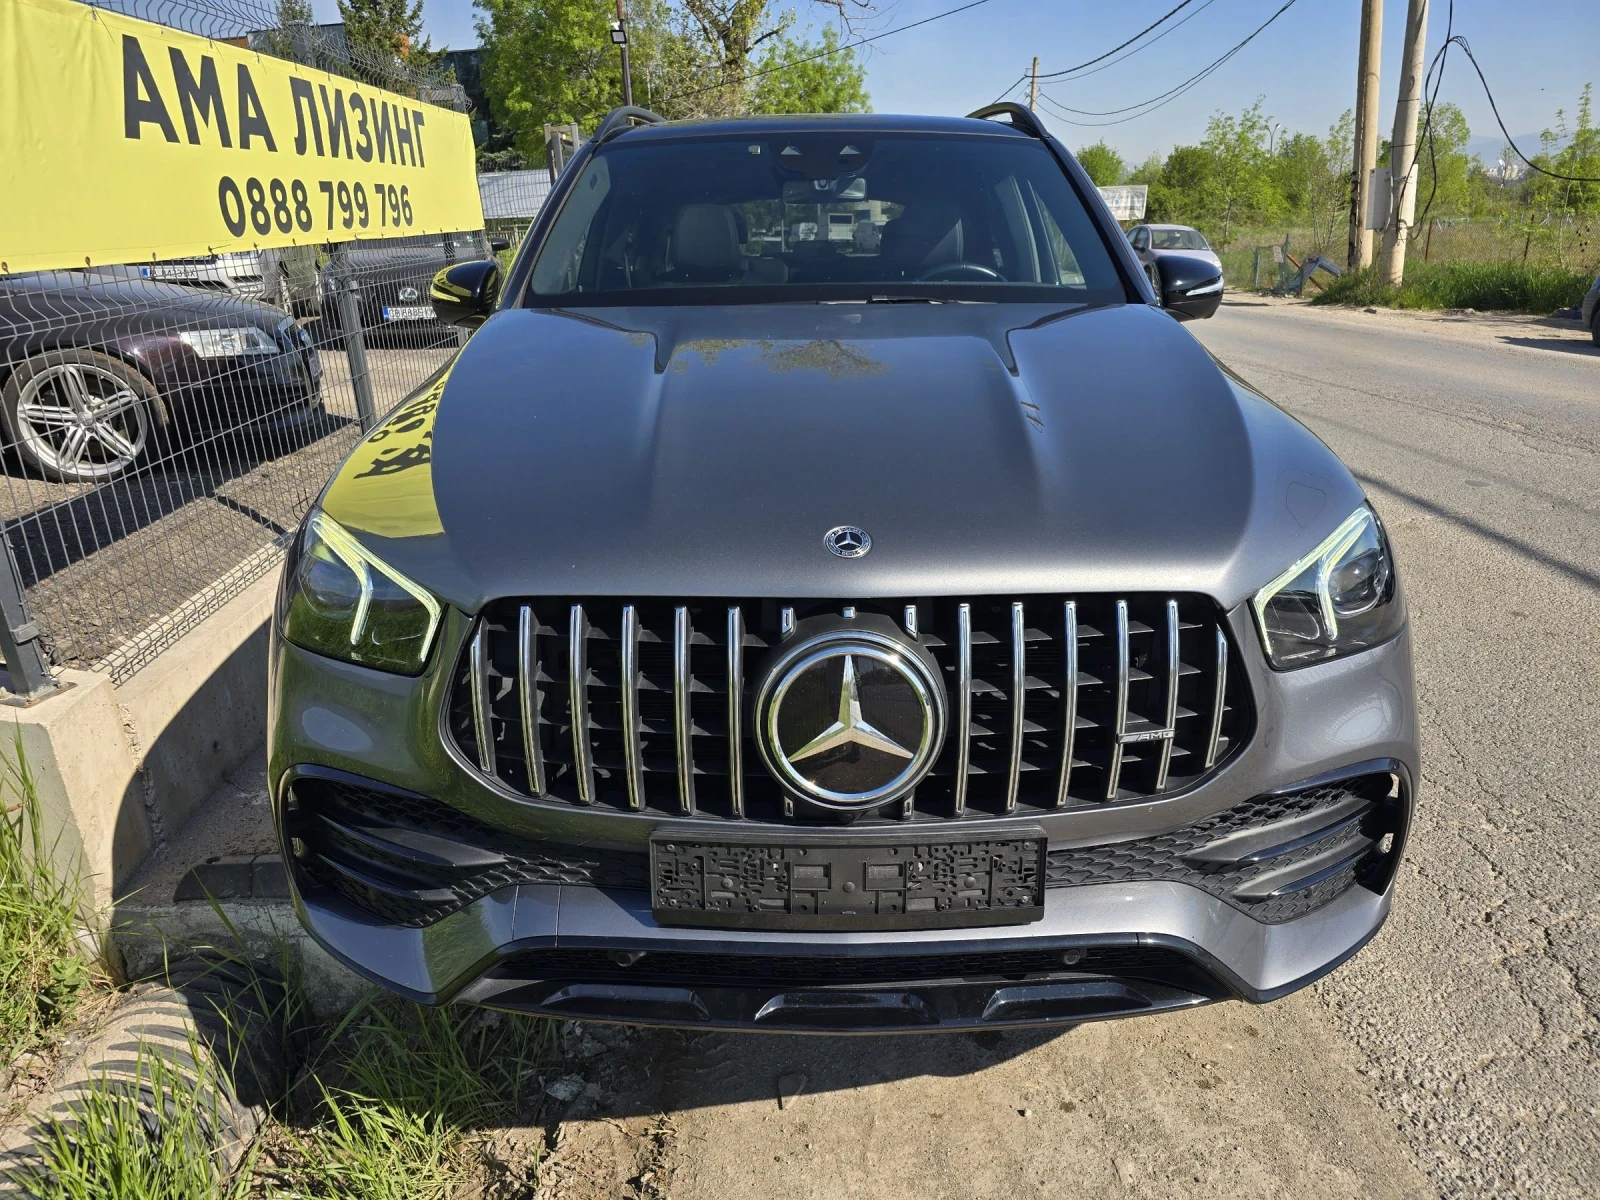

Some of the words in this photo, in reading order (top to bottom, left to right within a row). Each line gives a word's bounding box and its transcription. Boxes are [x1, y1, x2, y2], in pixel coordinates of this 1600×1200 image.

[122, 34, 278, 153] АМА
[289, 76, 425, 168] ЛИЗИНГ
[218, 176, 313, 238] 0888
[318, 180, 370, 231] 799
[374, 183, 413, 227] 796
[1137, 731, 1174, 741] AMG
